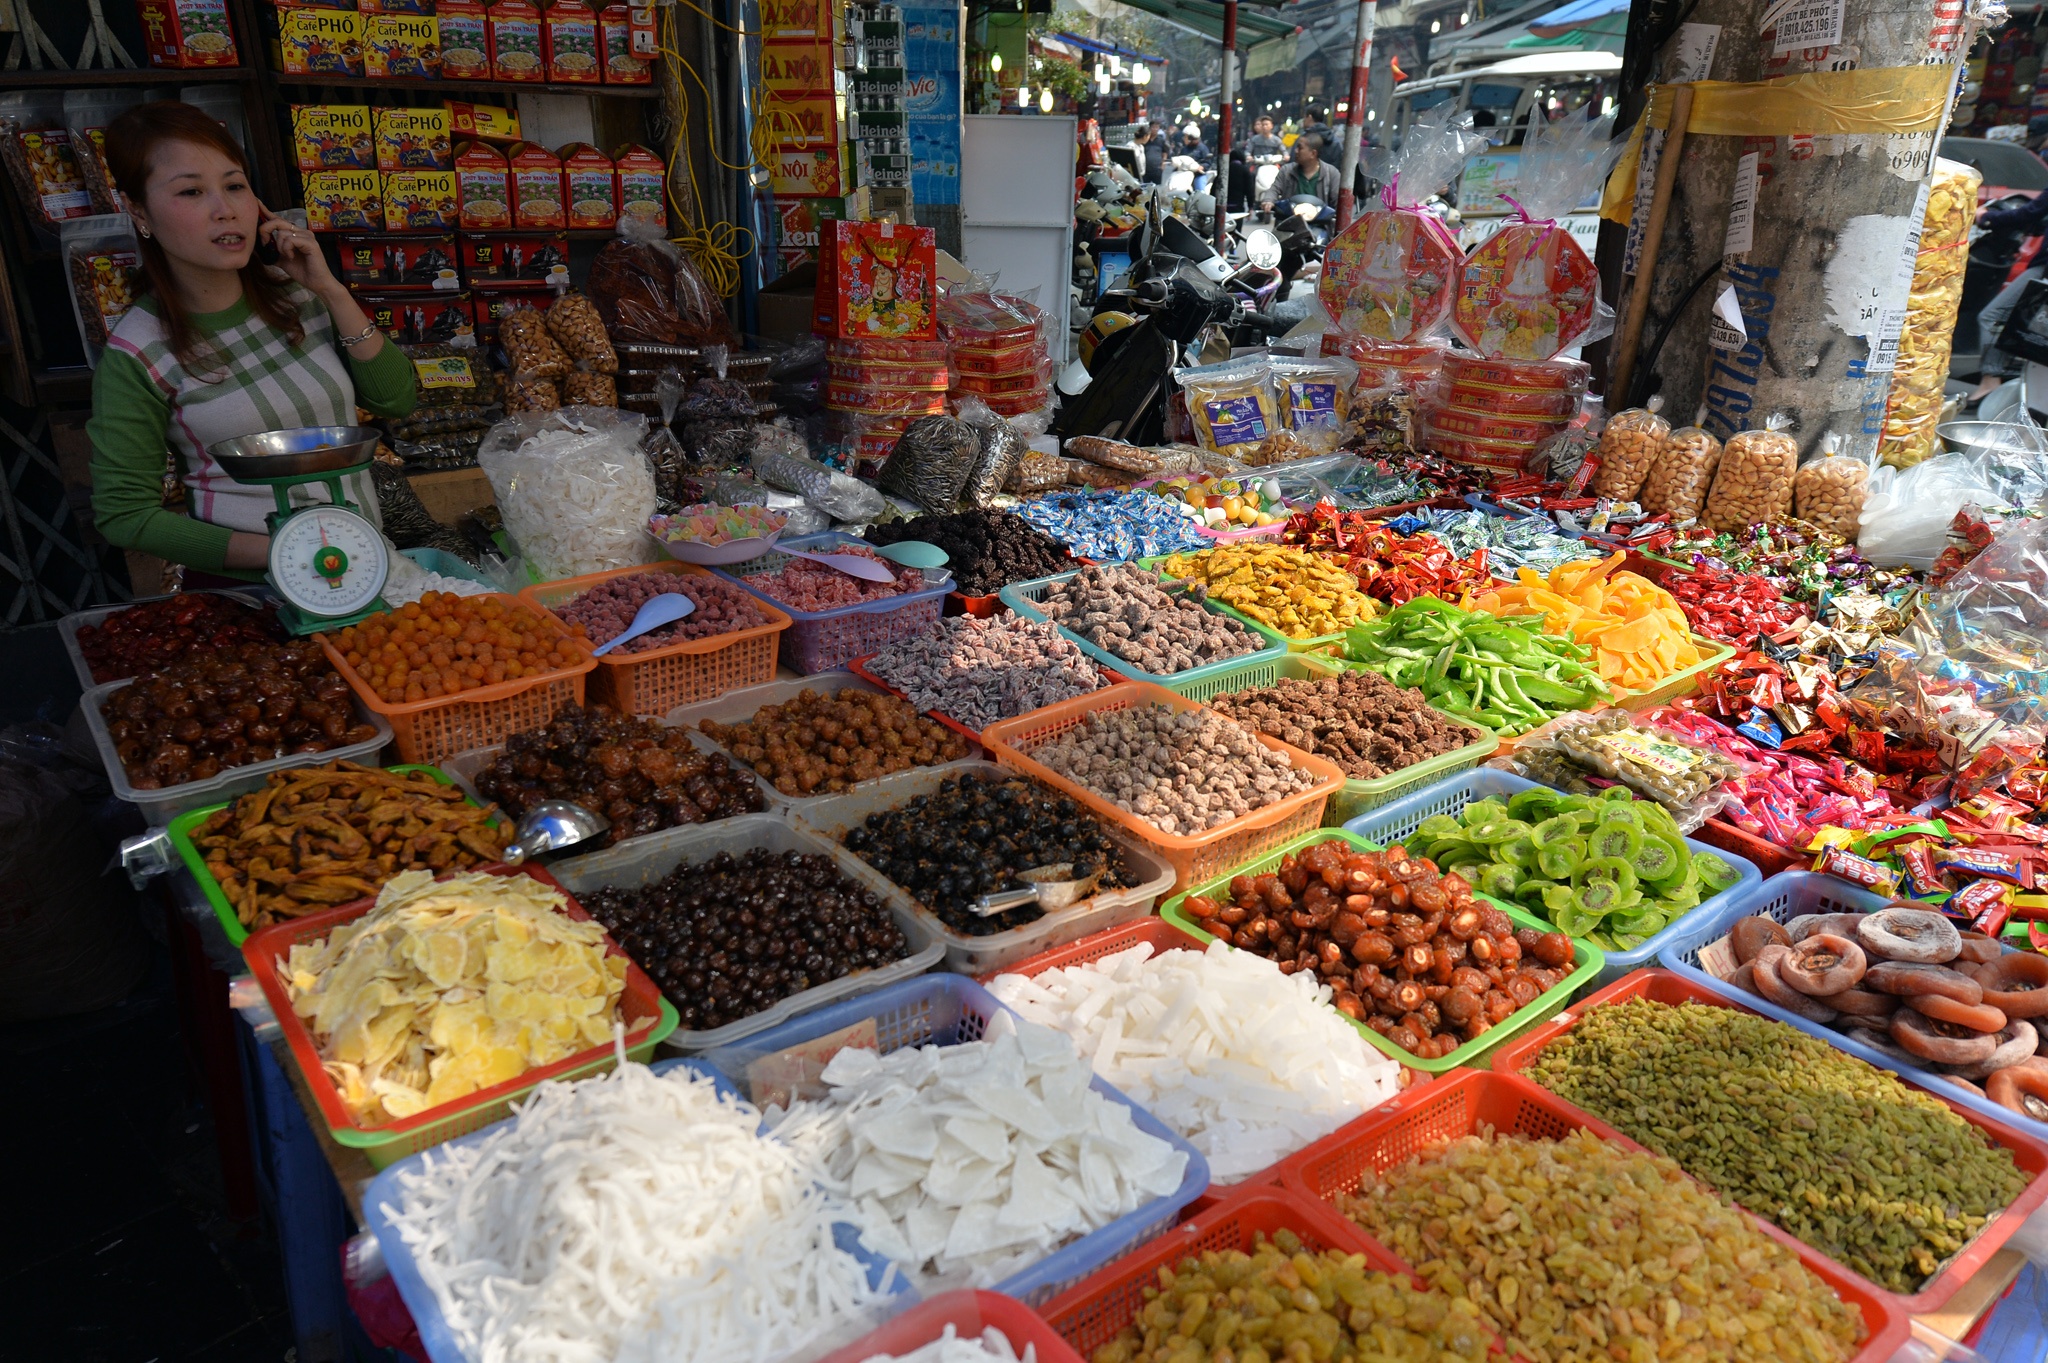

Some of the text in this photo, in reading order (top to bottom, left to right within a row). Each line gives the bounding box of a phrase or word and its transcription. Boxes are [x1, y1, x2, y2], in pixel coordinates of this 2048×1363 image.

[1786, 4, 1830, 22] HÚT BỂ PHỐT
[297, 15, 354, 33] Café PHỐ
[378, 20, 432, 38] Café PHỐ
[1784, 18, 1829, 36] 0918.425.196
[310, 109, 363, 128] Café PHỐ
[390, 112, 442, 130] Café PHỐ
[320, 173, 373, 191] Café PHỐ
[398, 175, 450, 192] Café PHỐ
[355, 245, 372, 258] G7
[476, 245, 491, 257] G7
[375, 310, 392, 321] G7
